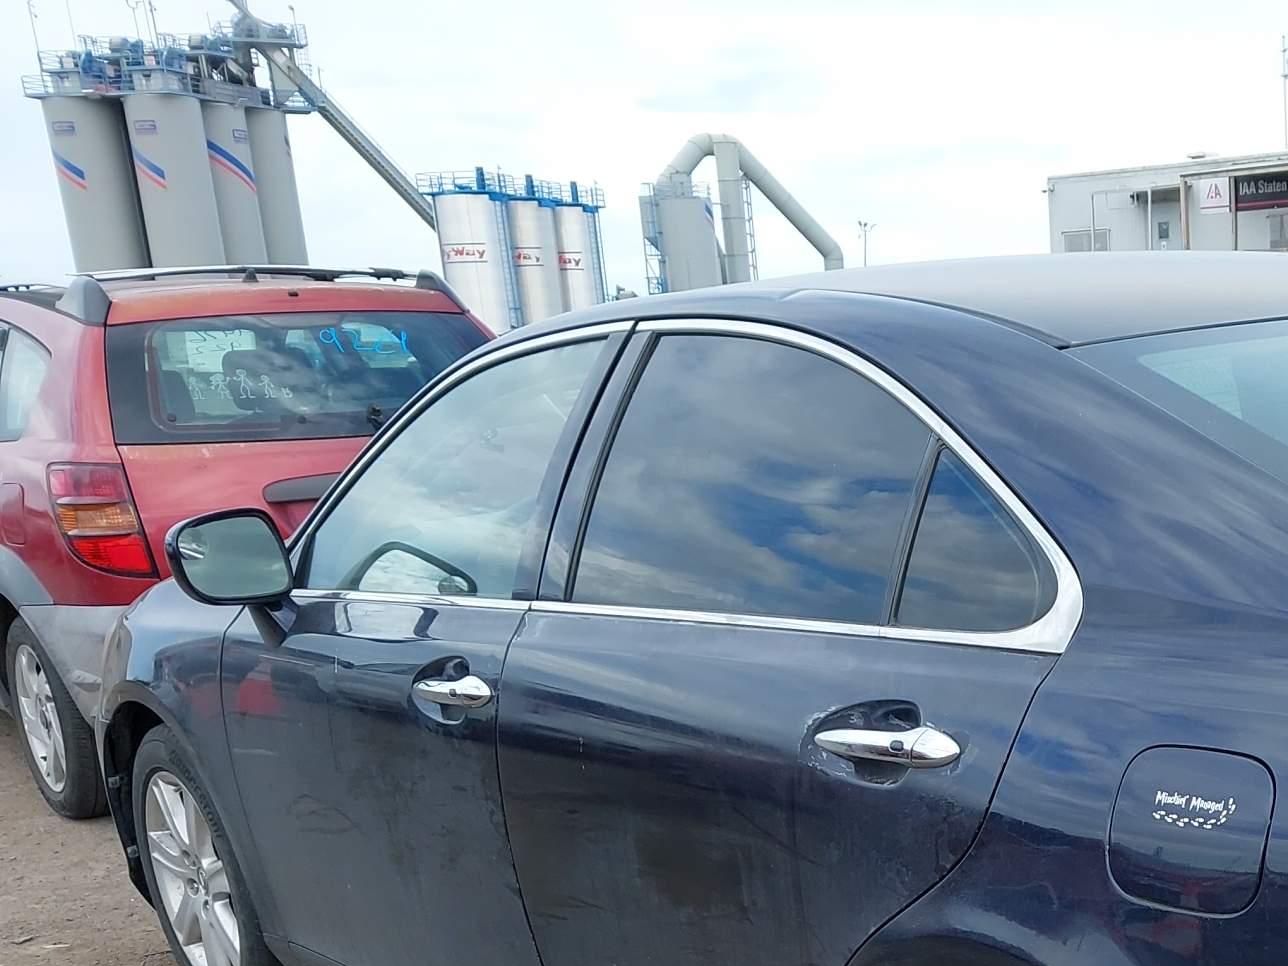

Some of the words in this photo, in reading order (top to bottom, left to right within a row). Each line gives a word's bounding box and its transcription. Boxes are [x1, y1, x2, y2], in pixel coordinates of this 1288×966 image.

[1239, 181, 1256, 195] IAA
[1258, 179, 1287, 194] Staten
[1155, 790, 1190, 809] Mischief
[1189, 796, 1225, 814] Managed
